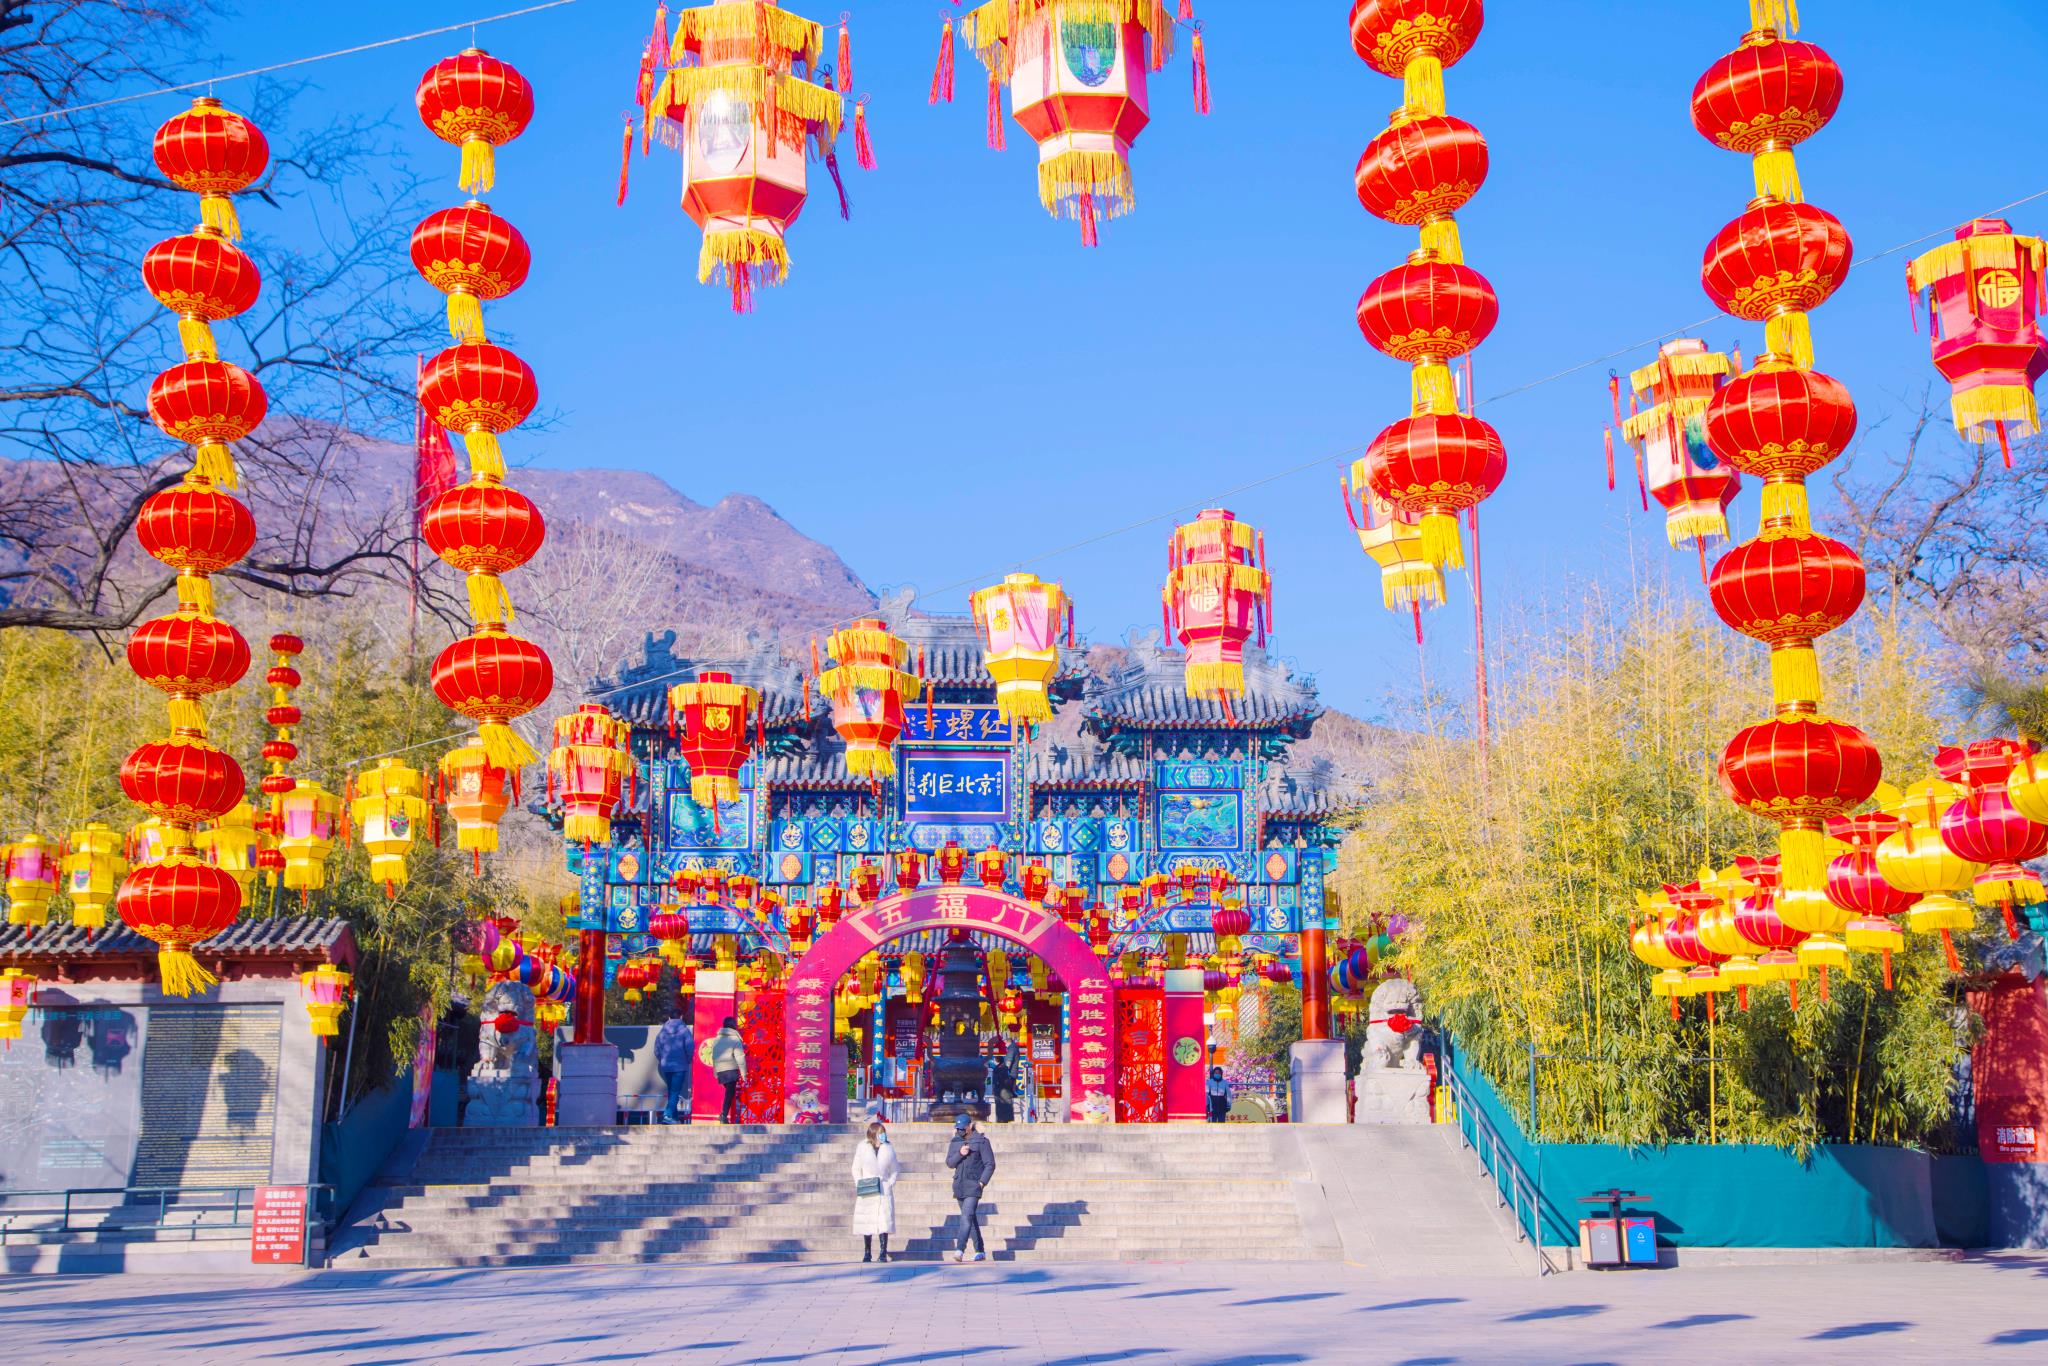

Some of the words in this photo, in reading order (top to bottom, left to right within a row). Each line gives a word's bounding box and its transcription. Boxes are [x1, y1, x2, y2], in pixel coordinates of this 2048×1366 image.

[1979, 271, 2020, 308] 福
[876, 894, 1030, 933] 五福门
[1078, 978, 1107, 1085] 红螺胜境春满园
[1997, 1127, 2035, 1144] 消防通道
